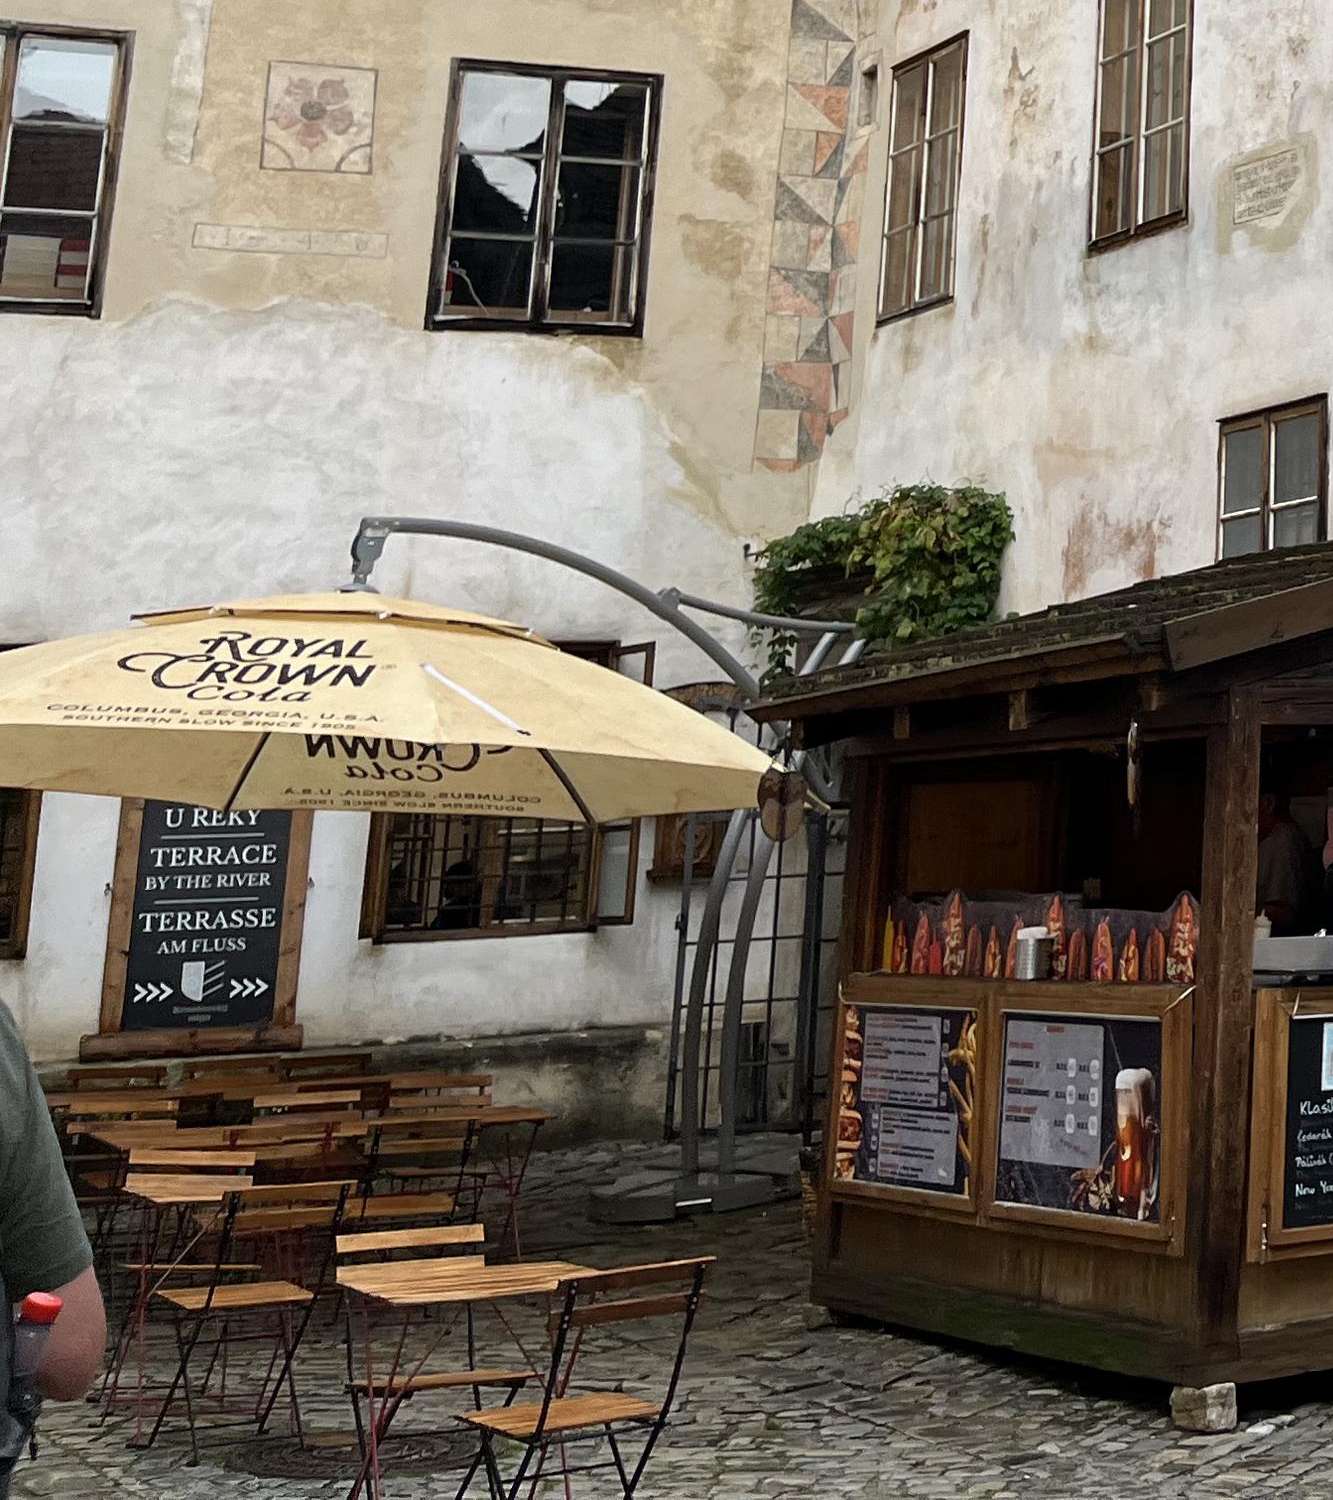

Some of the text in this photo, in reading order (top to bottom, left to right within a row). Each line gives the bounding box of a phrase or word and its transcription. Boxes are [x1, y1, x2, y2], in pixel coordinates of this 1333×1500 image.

[186, 684, 315, 702] Cola
[47, 703, 386, 723] COLUMBUS, GEORGIA, U.S.A.
[62, 714, 172, 724] SOUTHERN
[242, 719, 303, 728] SINCE
[165, 808, 183, 828] U
[150, 844, 277, 868] TERRACE
[144, 872, 271, 891] BY THE RIVER
[138, 907, 277, 933] TERRASSE
[157, 936, 247, 955] AM FLUSS
[1295, 1183, 1316, 1197] New
